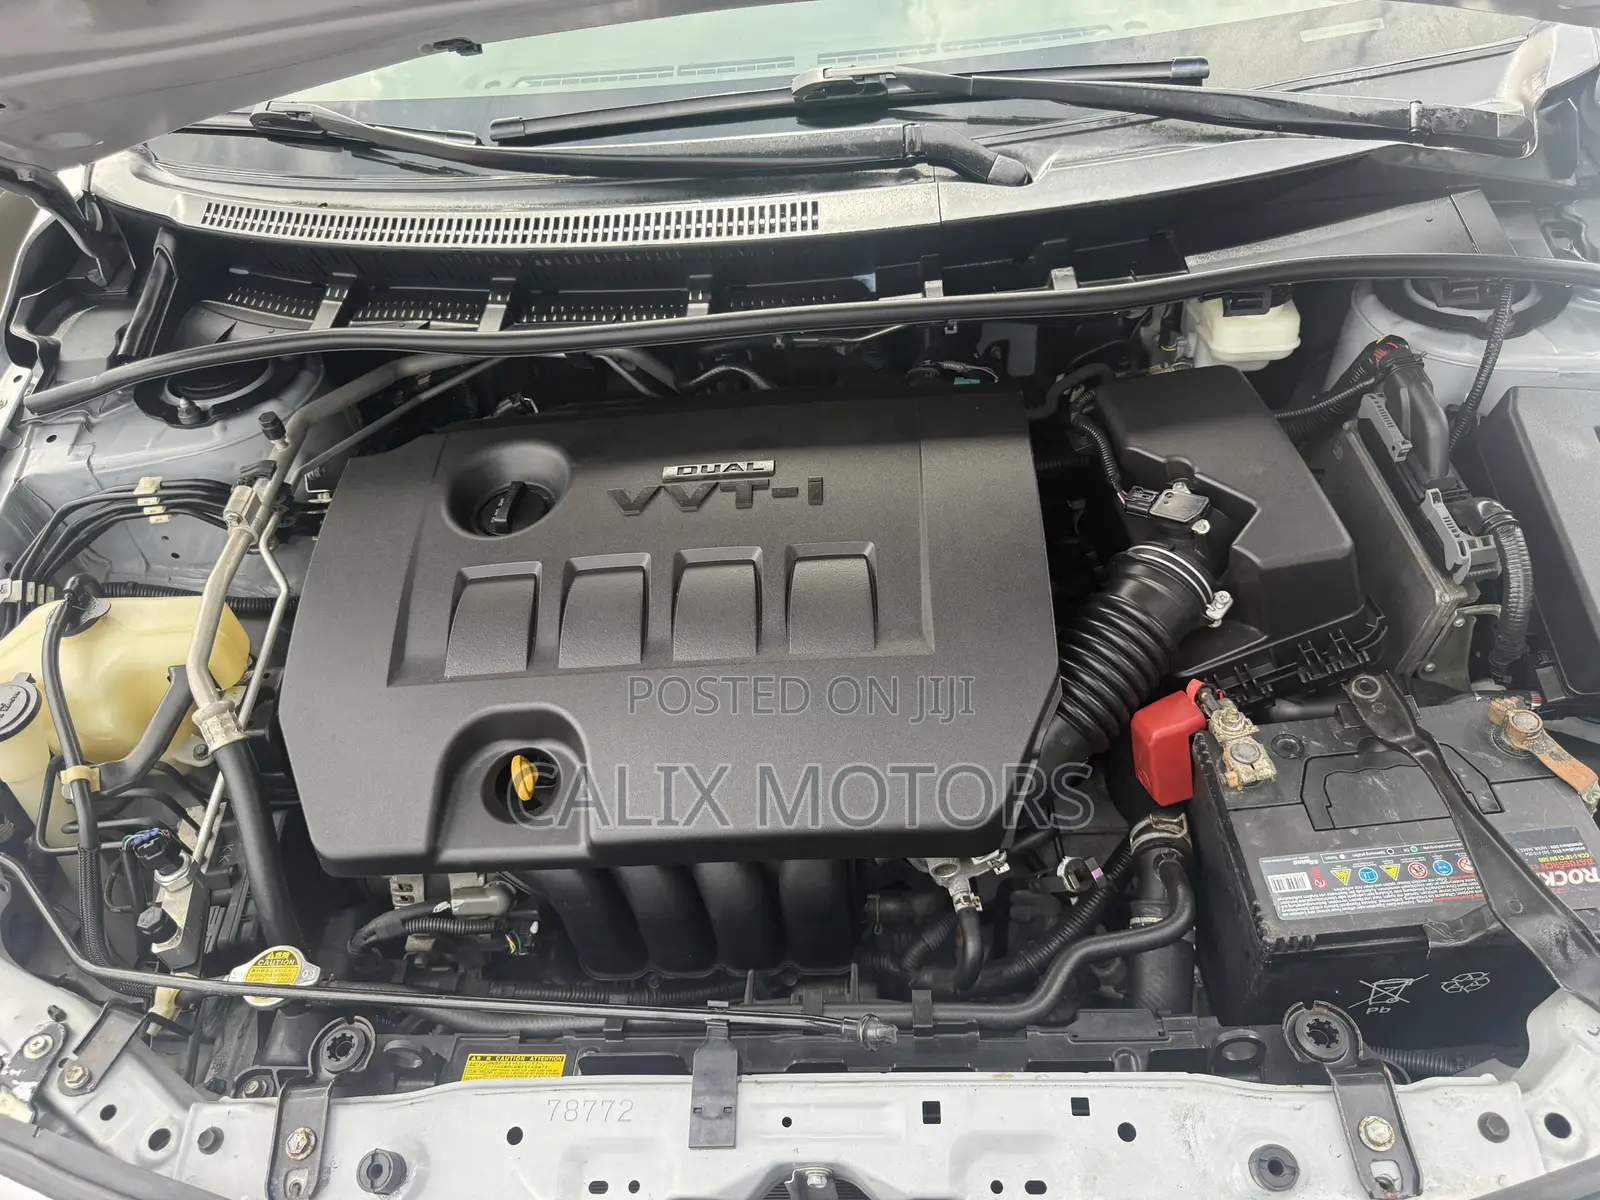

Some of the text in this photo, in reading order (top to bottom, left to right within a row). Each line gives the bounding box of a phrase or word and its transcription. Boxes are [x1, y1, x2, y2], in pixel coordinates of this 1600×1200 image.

[676, 462, 765, 476] DUAL
[1536, 867, 1600, 887] ROCK
[1366, 1006, 1391, 1015] Pb
[547, 1099, 634, 1122] 78772
